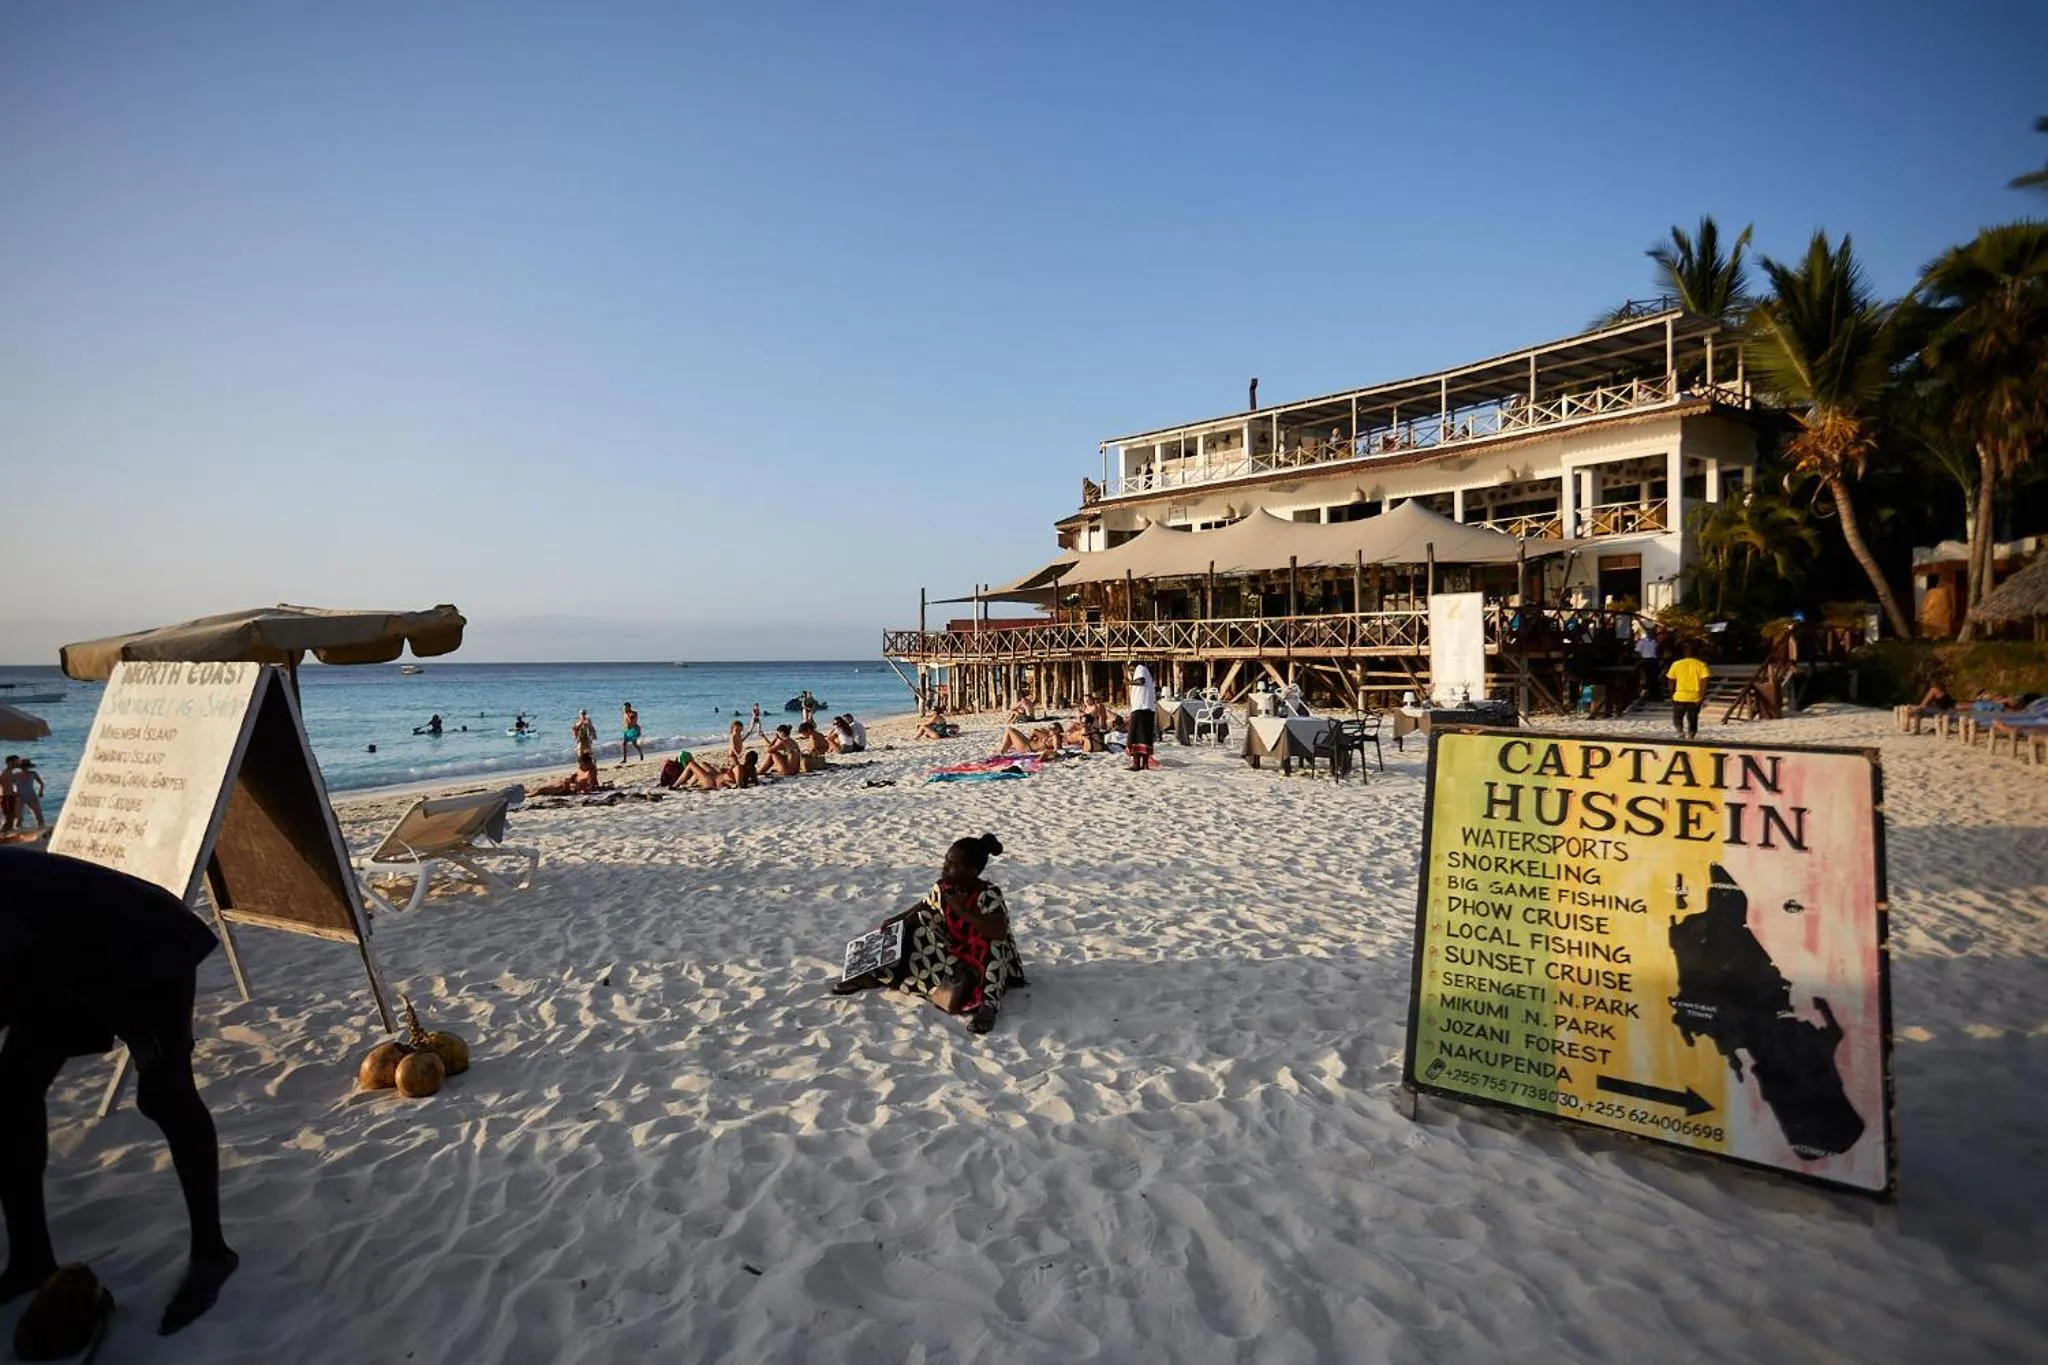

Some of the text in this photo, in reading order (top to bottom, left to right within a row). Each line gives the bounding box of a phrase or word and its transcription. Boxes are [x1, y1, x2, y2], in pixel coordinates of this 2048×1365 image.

[121, 662, 249, 687] NORTH COAST
[1497, 740, 1783, 795] CAPTAIN
[1482, 781, 1811, 852] HUSSEIN
[1462, 827, 1629, 862] WATERSPORTS
[1447, 851, 1601, 885] SNORKELING
[1447, 875, 1648, 914] BIG GAME FISHING
[1448, 896, 1610, 935] DHOW CRUISE
[1446, 920, 1631, 964] LOCAL FISHING
[1444, 945, 1633, 993] SUNSET CRUISE
[1440, 993, 1509, 1021] MIKUMI
[1554, 1015, 1617, 1041] PARK
[1442, 971, 1546, 1003] SERENGETI
[1583, 995, 1640, 1020] PARK
[1439, 1018, 1612, 1065] JOZANI FOREST
[1439, 1040, 1573, 1083] NAKUPENDA
